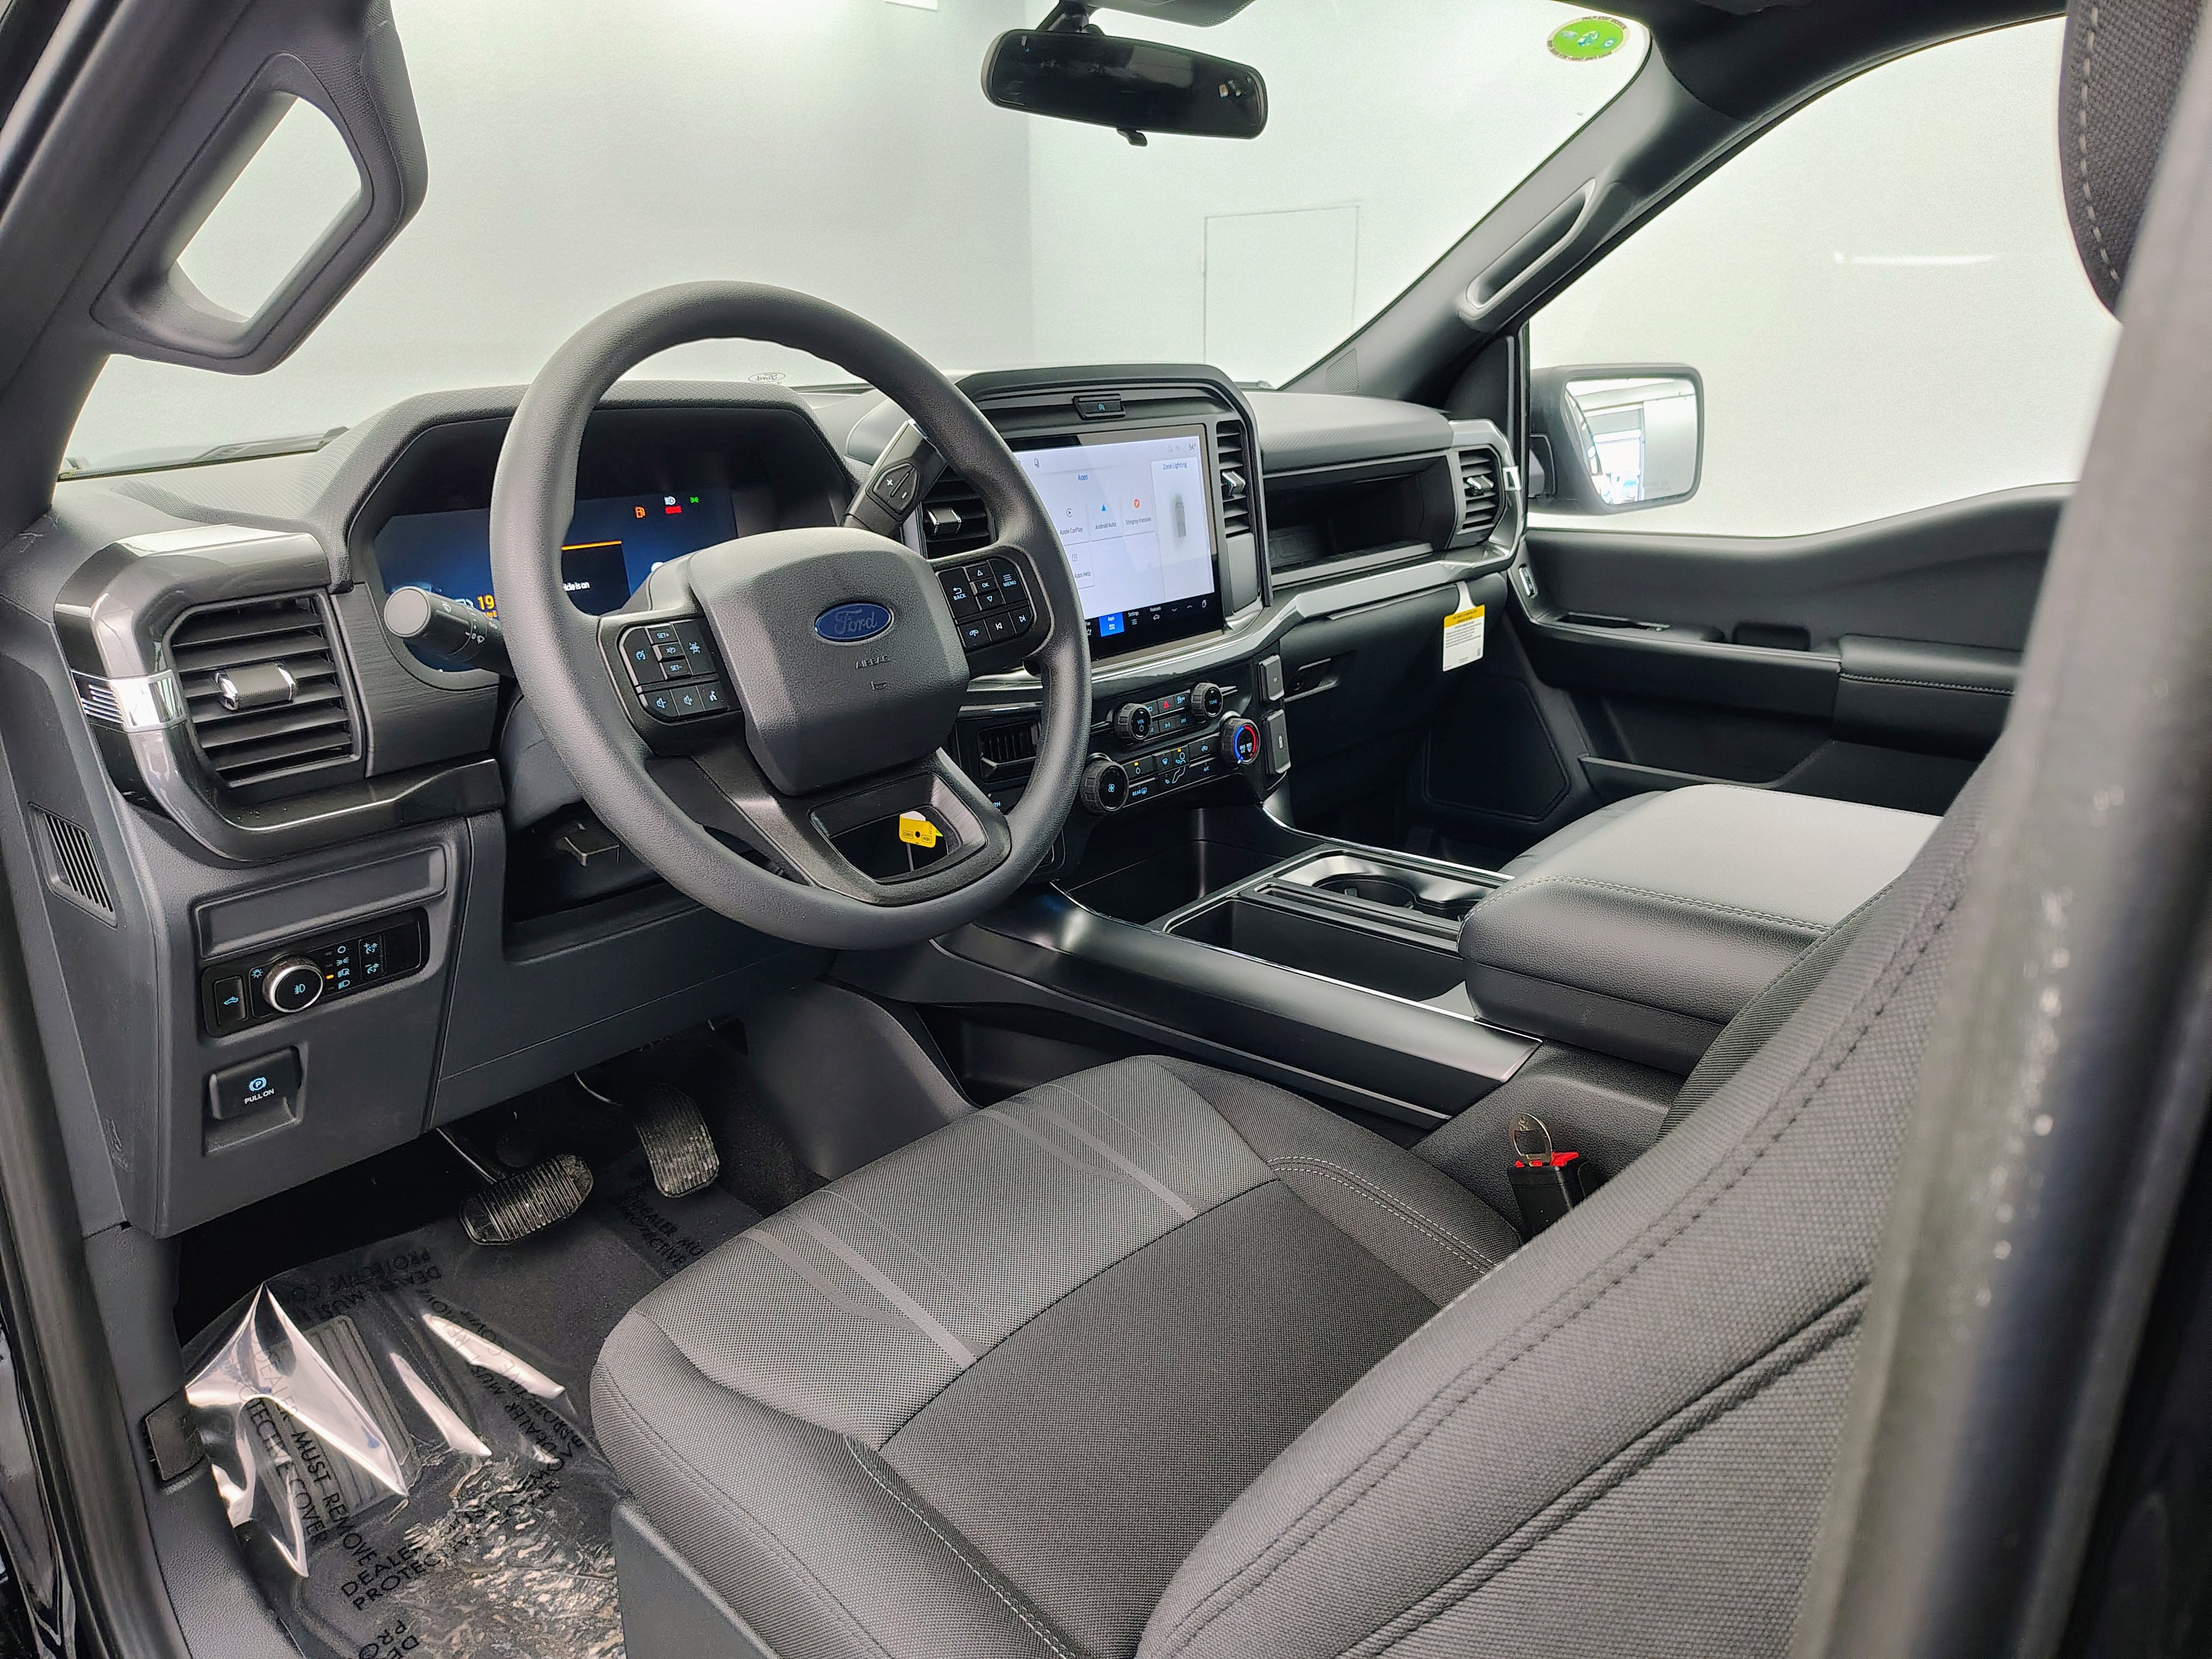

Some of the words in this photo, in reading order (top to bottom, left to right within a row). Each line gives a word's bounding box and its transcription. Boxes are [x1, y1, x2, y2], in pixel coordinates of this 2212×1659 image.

[477, 595, 495, 610] 19
[656, 631, 670, 639] SET+
[835, 609, 878, 635] Ford
[245, 1094, 263, 1104] PULL
[263, 1088, 274, 1097] ON
[504, 1400, 557, 1454] DEALER
[288, 1478, 329, 1543] COVER
[292, 1429, 331, 1482] MUST
[321, 1491, 378, 1567] REMOVE
